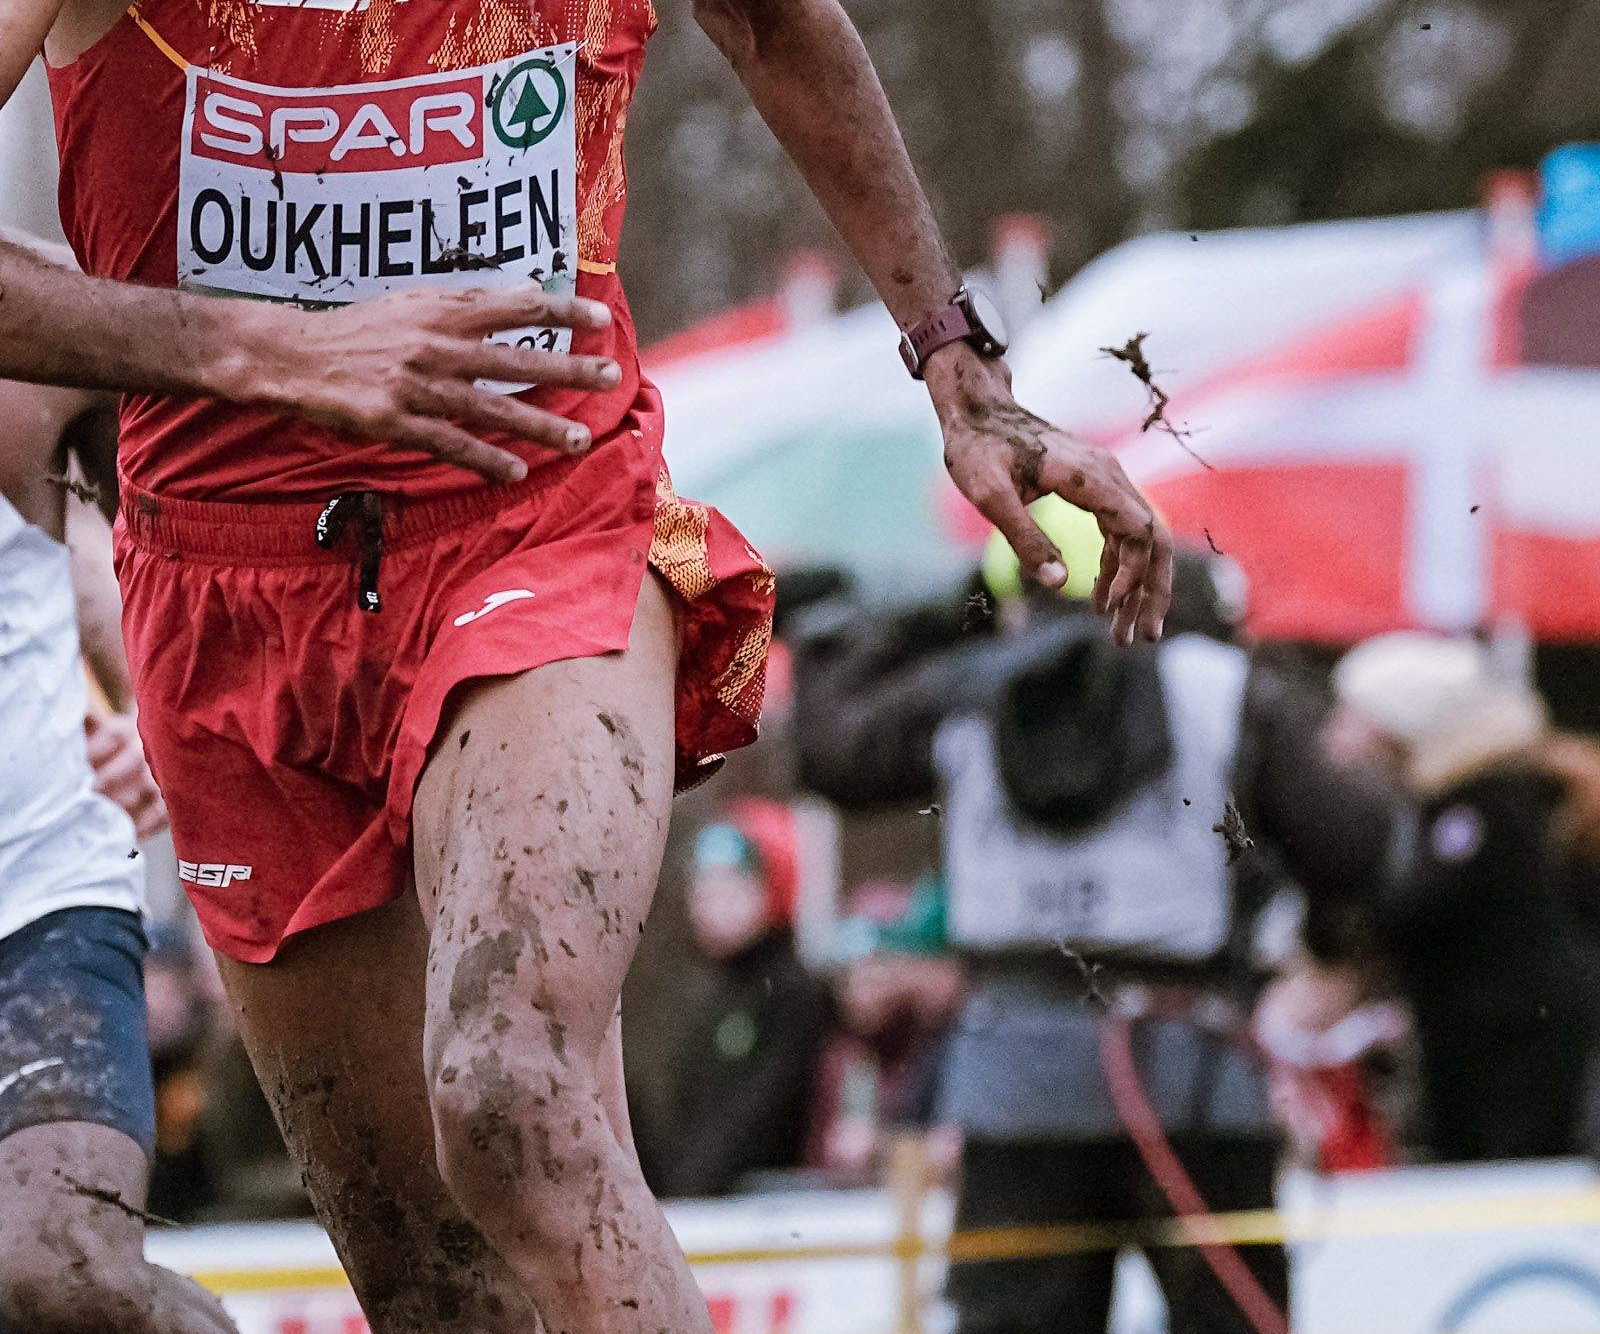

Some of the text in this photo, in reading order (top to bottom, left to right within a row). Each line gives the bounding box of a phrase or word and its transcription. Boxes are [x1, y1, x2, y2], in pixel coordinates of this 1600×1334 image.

[199, 90, 477, 163] SPAR
[189, 168, 561, 278] OUKHELEEN
[178, 858, 253, 888] ESP
